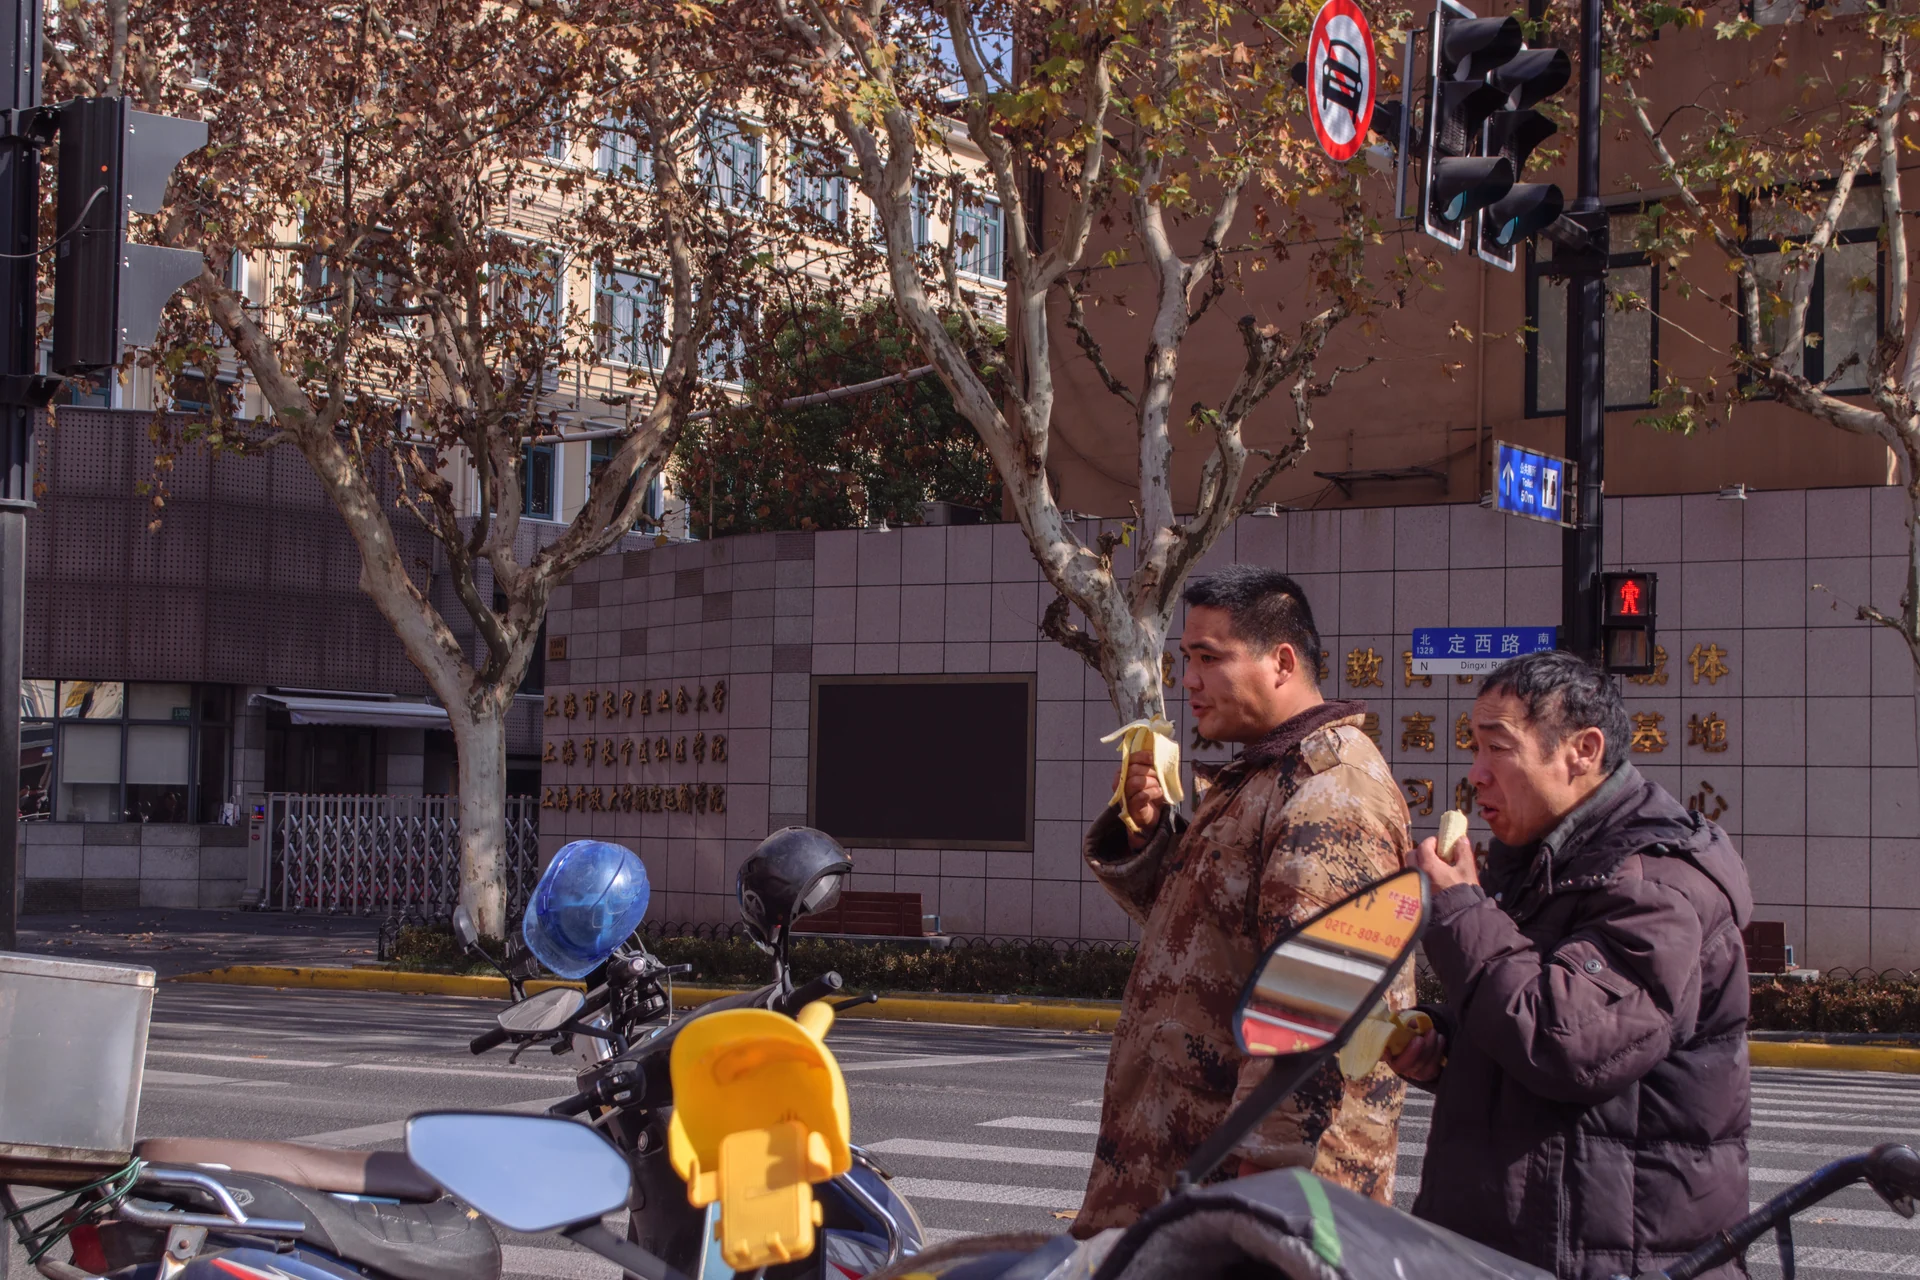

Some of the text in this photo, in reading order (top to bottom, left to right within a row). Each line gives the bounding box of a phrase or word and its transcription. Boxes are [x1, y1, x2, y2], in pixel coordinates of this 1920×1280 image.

[1420, 634, 1431, 646] 北
[1447, 633, 1520, 654] 定西路
[1538, 632, 1550, 645] 南
[1416, 646, 1434, 655] 1328
[1420, 661, 1429, 671] N
[1460, 661, 1487, 671] Dingxi
